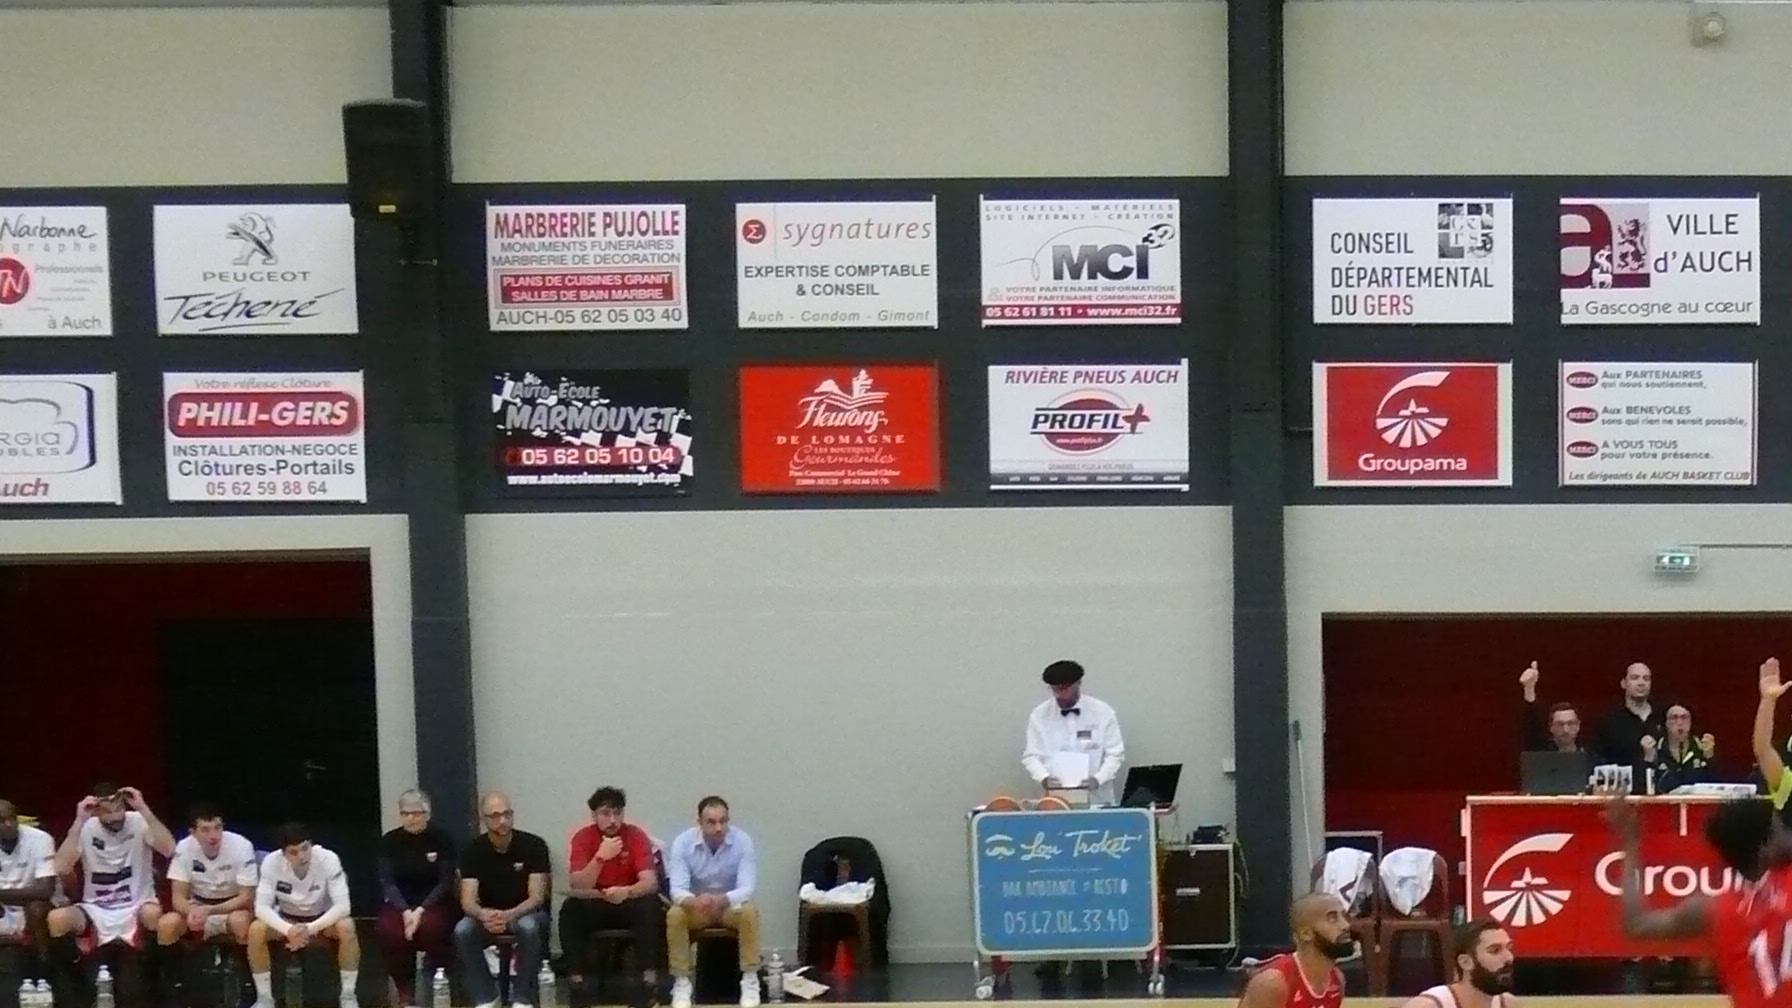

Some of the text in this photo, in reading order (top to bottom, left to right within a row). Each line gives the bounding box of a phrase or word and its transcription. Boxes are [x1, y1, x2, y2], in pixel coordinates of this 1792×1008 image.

[0, 213, 97, 238] Narbonne
[494, 211, 680, 238] MARBRERIE PUJOLLE
[1667, 214, 1738, 235] VILLE
[783, 218, 932, 247] sygnatures
[501, 239, 674, 253] MONUMENTS FUNERAIRES
[1331, 232, 1414, 254] CONSEIL
[492, 253, 680, 266] MARBRERIE DE DECORATION
[1052, 244, 1149, 280] MCI
[1654, 251, 1752, 273] d'AUCH
[203, 271, 310, 282] PEUGEOT
[744, 264, 930, 278] EXPERTISE COMPTABLE
[1331, 261, 1494, 288] DÉPARTEMENTAL
[503, 273, 669, 287] PLANS DE CUISINES GRANIT
[512, 289, 663, 302] SALLES DE BAIN MARBRE
[796, 284, 879, 295] & CONSEIL
[986, 306, 1177, 317] 05 62 www.mci32.fr
[1331, 295, 1413, 315] DU GERS
[1561, 302, 1579, 315] La
[1585, 301, 1671, 316] Gascogne
[1678, 304, 1698, 313] au
[62, 315, 101, 329] Auch
[581, 309, 601, 323] 62
[608, 309, 628, 323] 05
[634, 308, 655, 322] 03
[661, 308, 682, 321] 40
[748, 310, 930, 322] Auch Condom Gimont
[1005, 367, 1179, 384] RIVIÈRE PNEUS AUCH
[1602, 370, 1702, 379] Aux PARTENAIRES
[177, 401, 349, 427] PHILI-GERS
[795, 398, 888, 433] Fleurons
[1601, 406, 1621, 414] Aux
[506, 405, 677, 432] MARMOUYET
[777, 435, 905, 444] DE LOMAGNE
[1613, 441, 1678, 449] VOUS TOUS
[173, 444, 358, 457] INSTALLATION-NEGOCE
[522, 448, 674, 464] 05 62 05 10 04
[178, 459, 355, 476] Clôtures-Portails
[1358, 453, 1467, 474] Groupama
[1650, 471, 1679, 480] AUCH
[1682, 471, 1721, 480] BASKET
[1724, 471, 1750, 480] CLUB
[207, 481, 327, 495] 05 62 59 88 64
